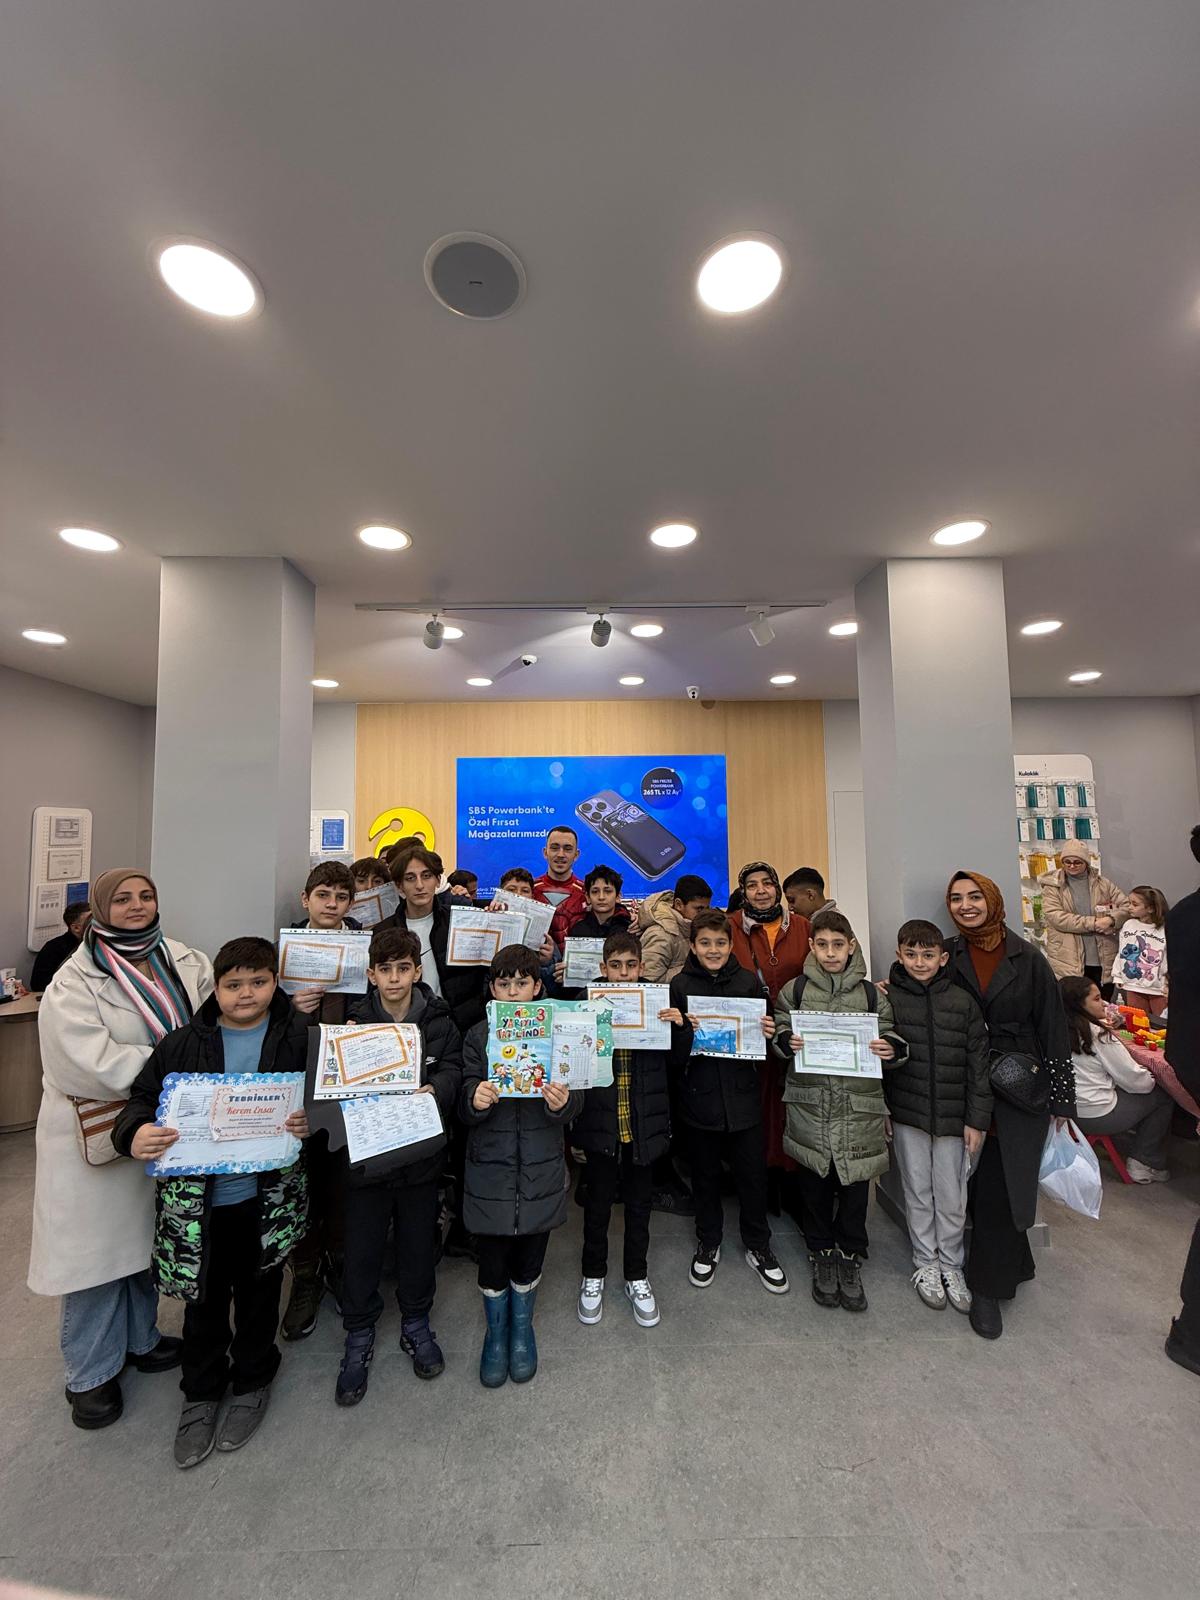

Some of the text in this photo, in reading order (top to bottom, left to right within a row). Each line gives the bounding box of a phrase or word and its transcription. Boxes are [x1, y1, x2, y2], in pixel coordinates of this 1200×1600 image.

[468, 806, 555, 815] SBS Powerbank'te
[468, 816, 519, 826] Özel Fırsat
[536, 1008, 545, 1021] 3
